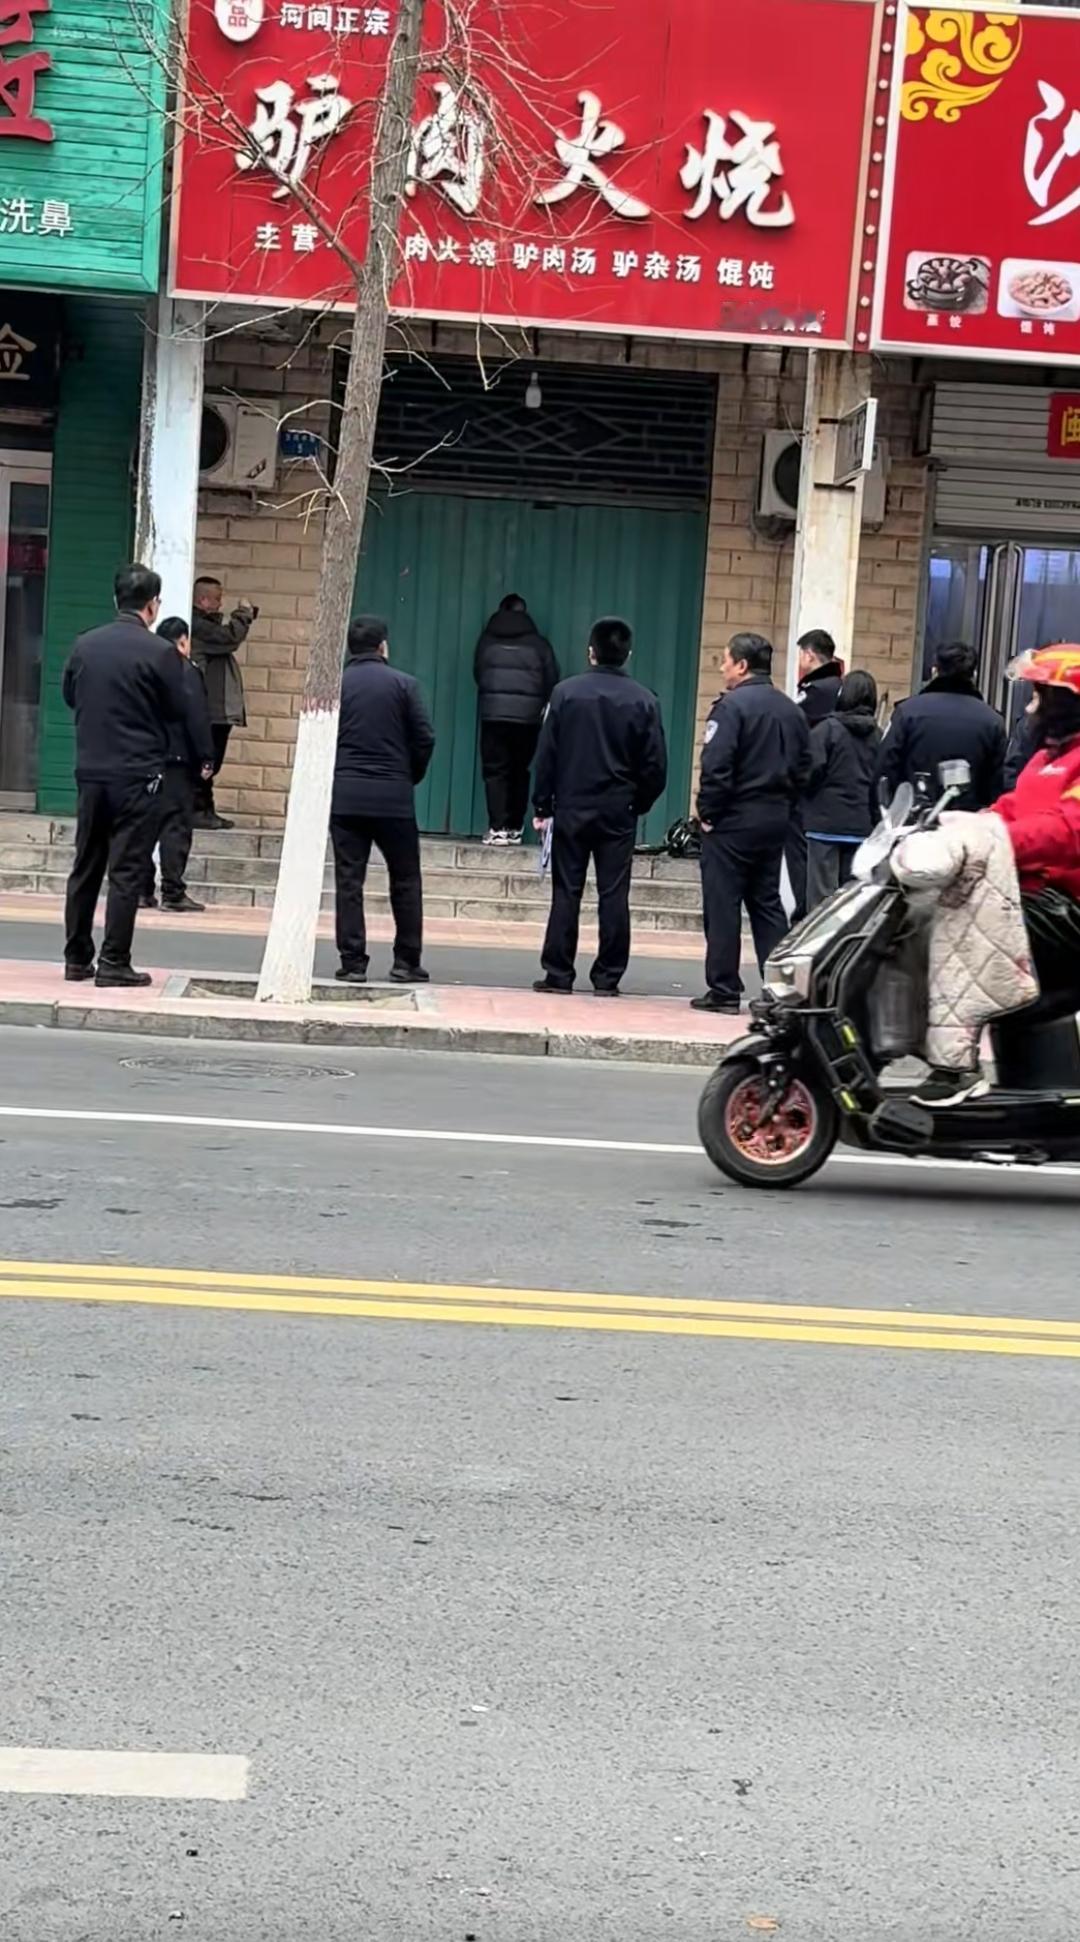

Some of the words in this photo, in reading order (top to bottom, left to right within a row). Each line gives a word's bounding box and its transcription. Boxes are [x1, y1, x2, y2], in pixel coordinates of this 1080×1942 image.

[280, 2, 390, 36] 河间正宗
[235, 73, 795, 228] 驴肉火烧
[0, 198, 75, 237] 洗鼻
[404, 233, 497, 267] 肉火烧
[513, 243, 596, 275] 驴肉汤
[612, 250, 702, 282] 驴杂汤
[717, 257, 775, 290] 馄饨
